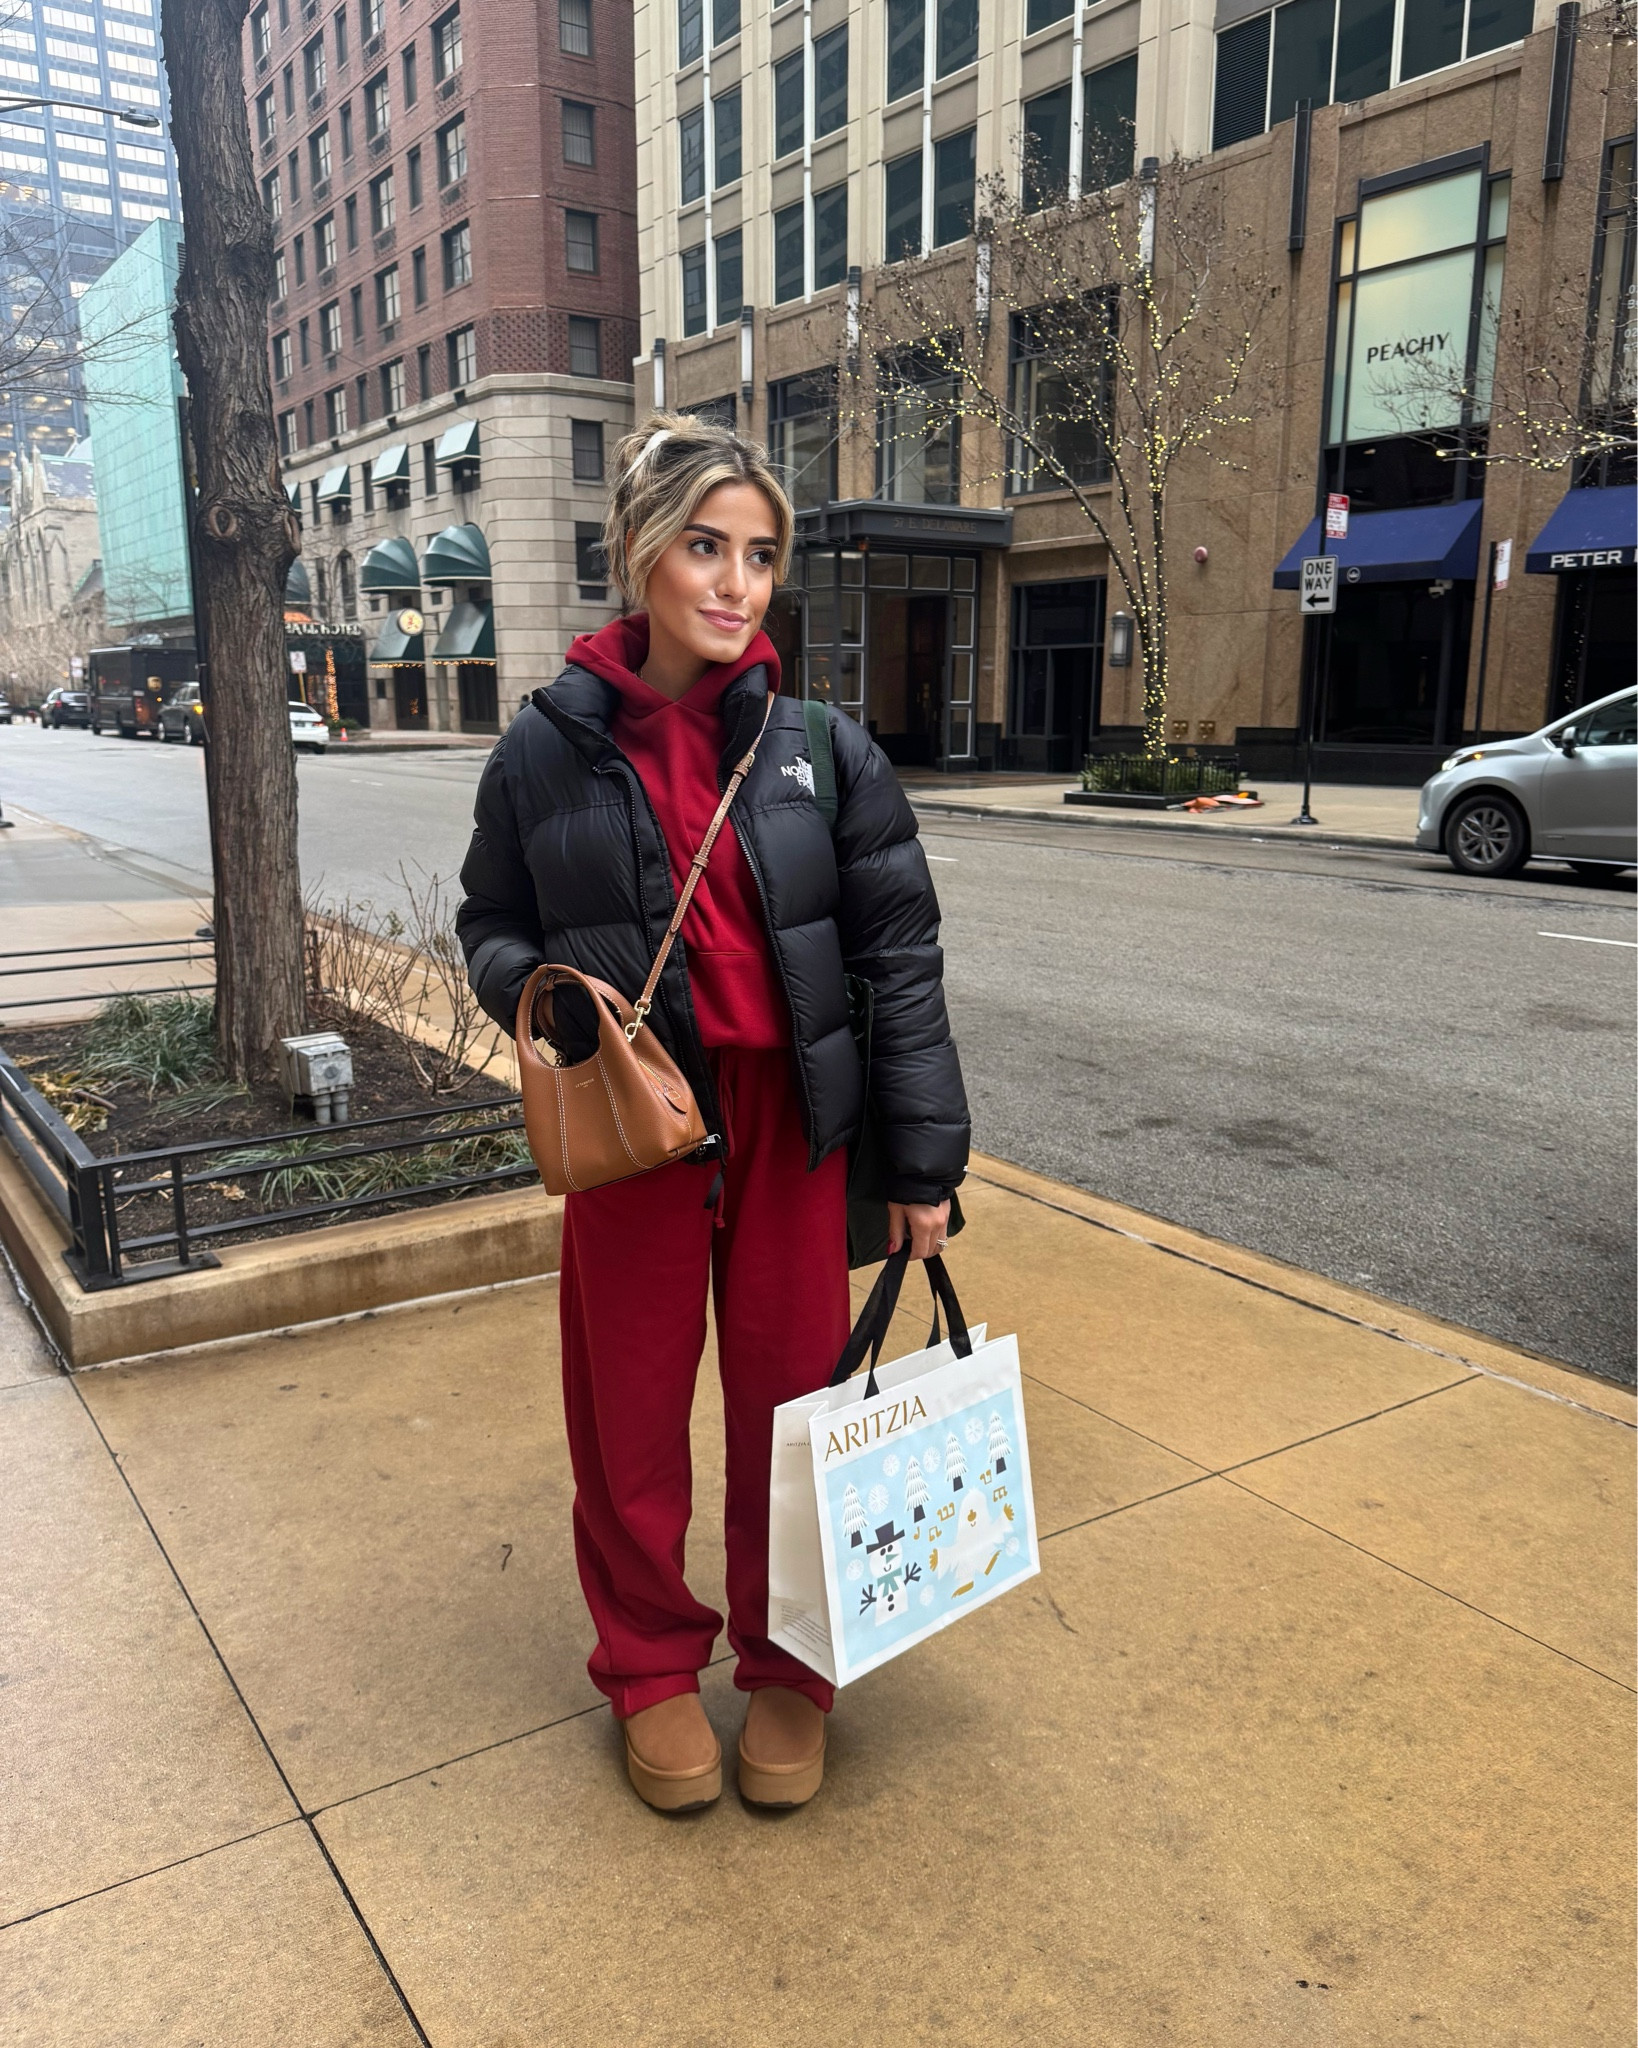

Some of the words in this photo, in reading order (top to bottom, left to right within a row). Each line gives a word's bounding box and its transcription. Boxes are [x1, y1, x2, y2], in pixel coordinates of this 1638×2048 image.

[1366, 331, 1450, 364] PEACHY
[922, 518, 977, 534] DELAWARE
[1550, 550, 1623, 569] PETER
[1305, 561, 1333, 576] ONE
[1304, 577, 1333, 591] WAY
[825, 1395, 927, 1462] ARITZIA
